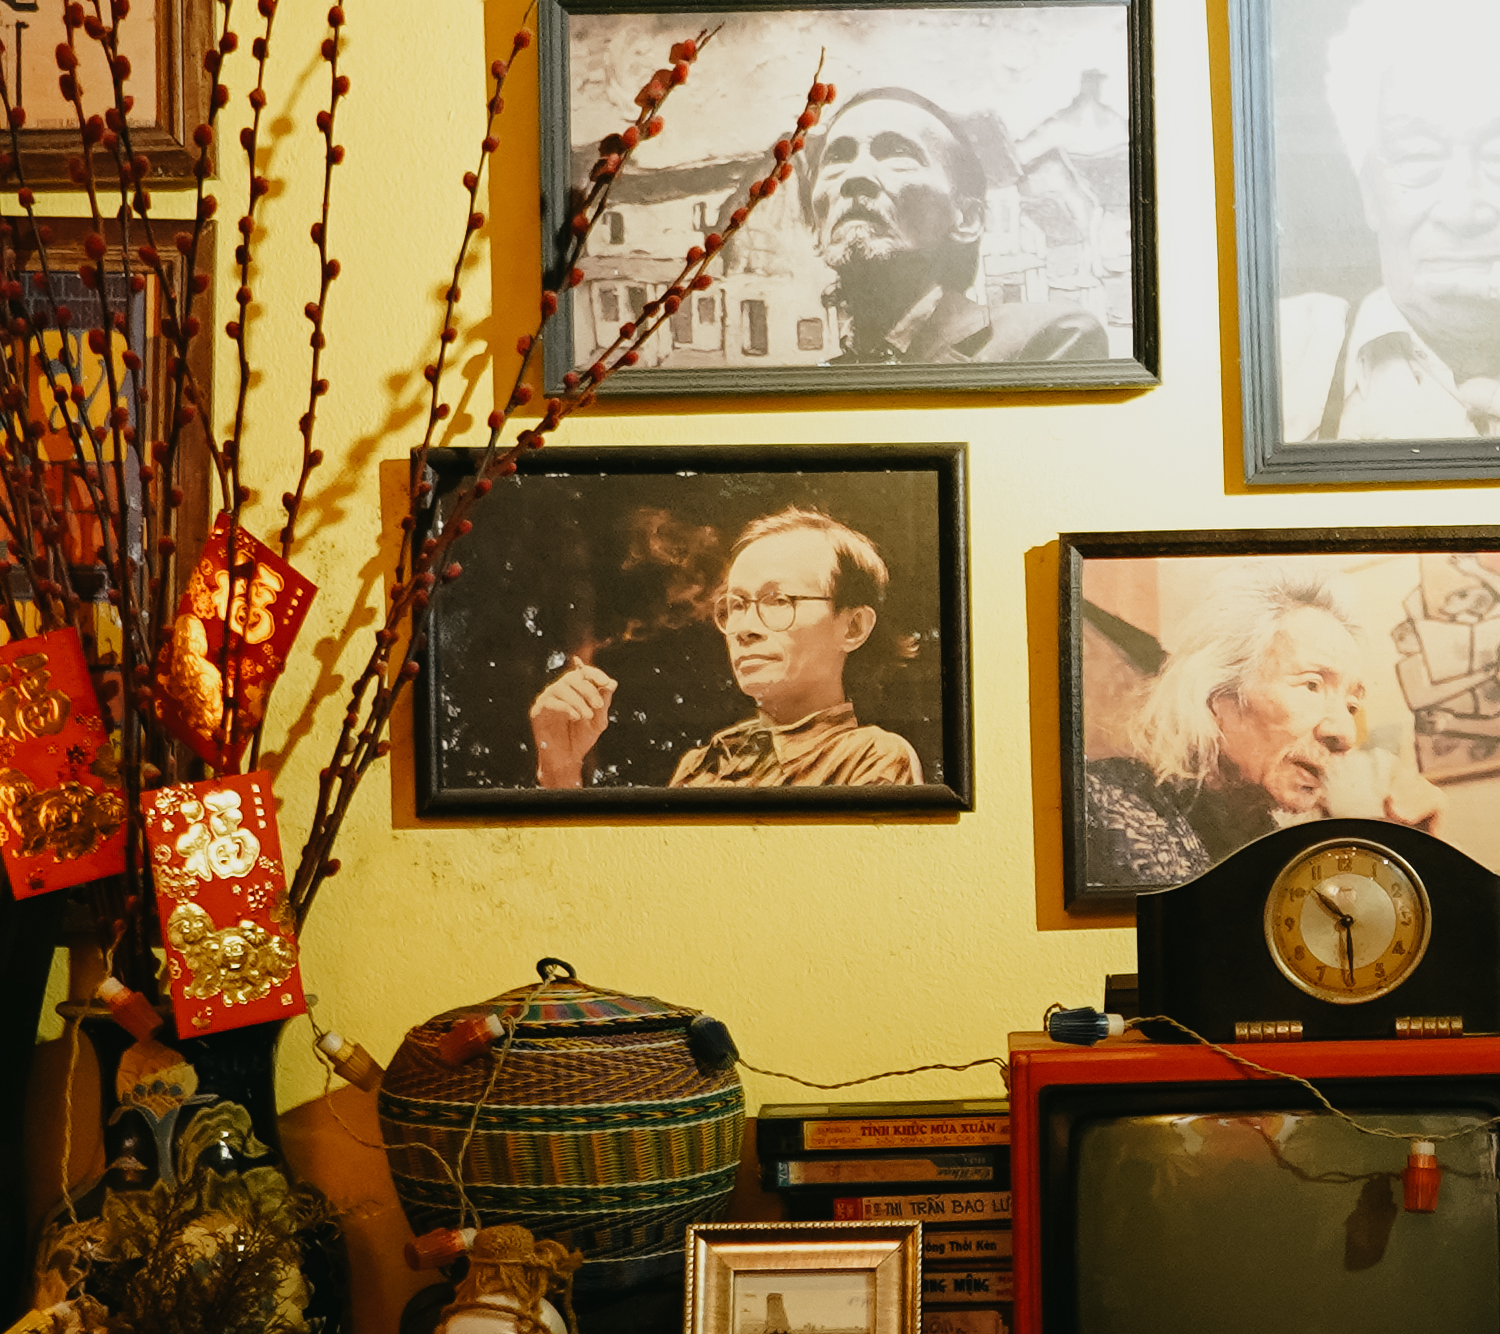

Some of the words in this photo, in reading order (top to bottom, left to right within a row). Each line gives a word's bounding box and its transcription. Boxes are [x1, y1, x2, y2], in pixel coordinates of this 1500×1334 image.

[1311, 865, 1323, 881] 11
[1391, 882, 1403, 899] 2
[1284, 917, 1296, 933] 9
[1391, 940, 1406, 956] 4
[1314, 964, 1327, 982] 7
[1374, 961, 1386, 979] 5
